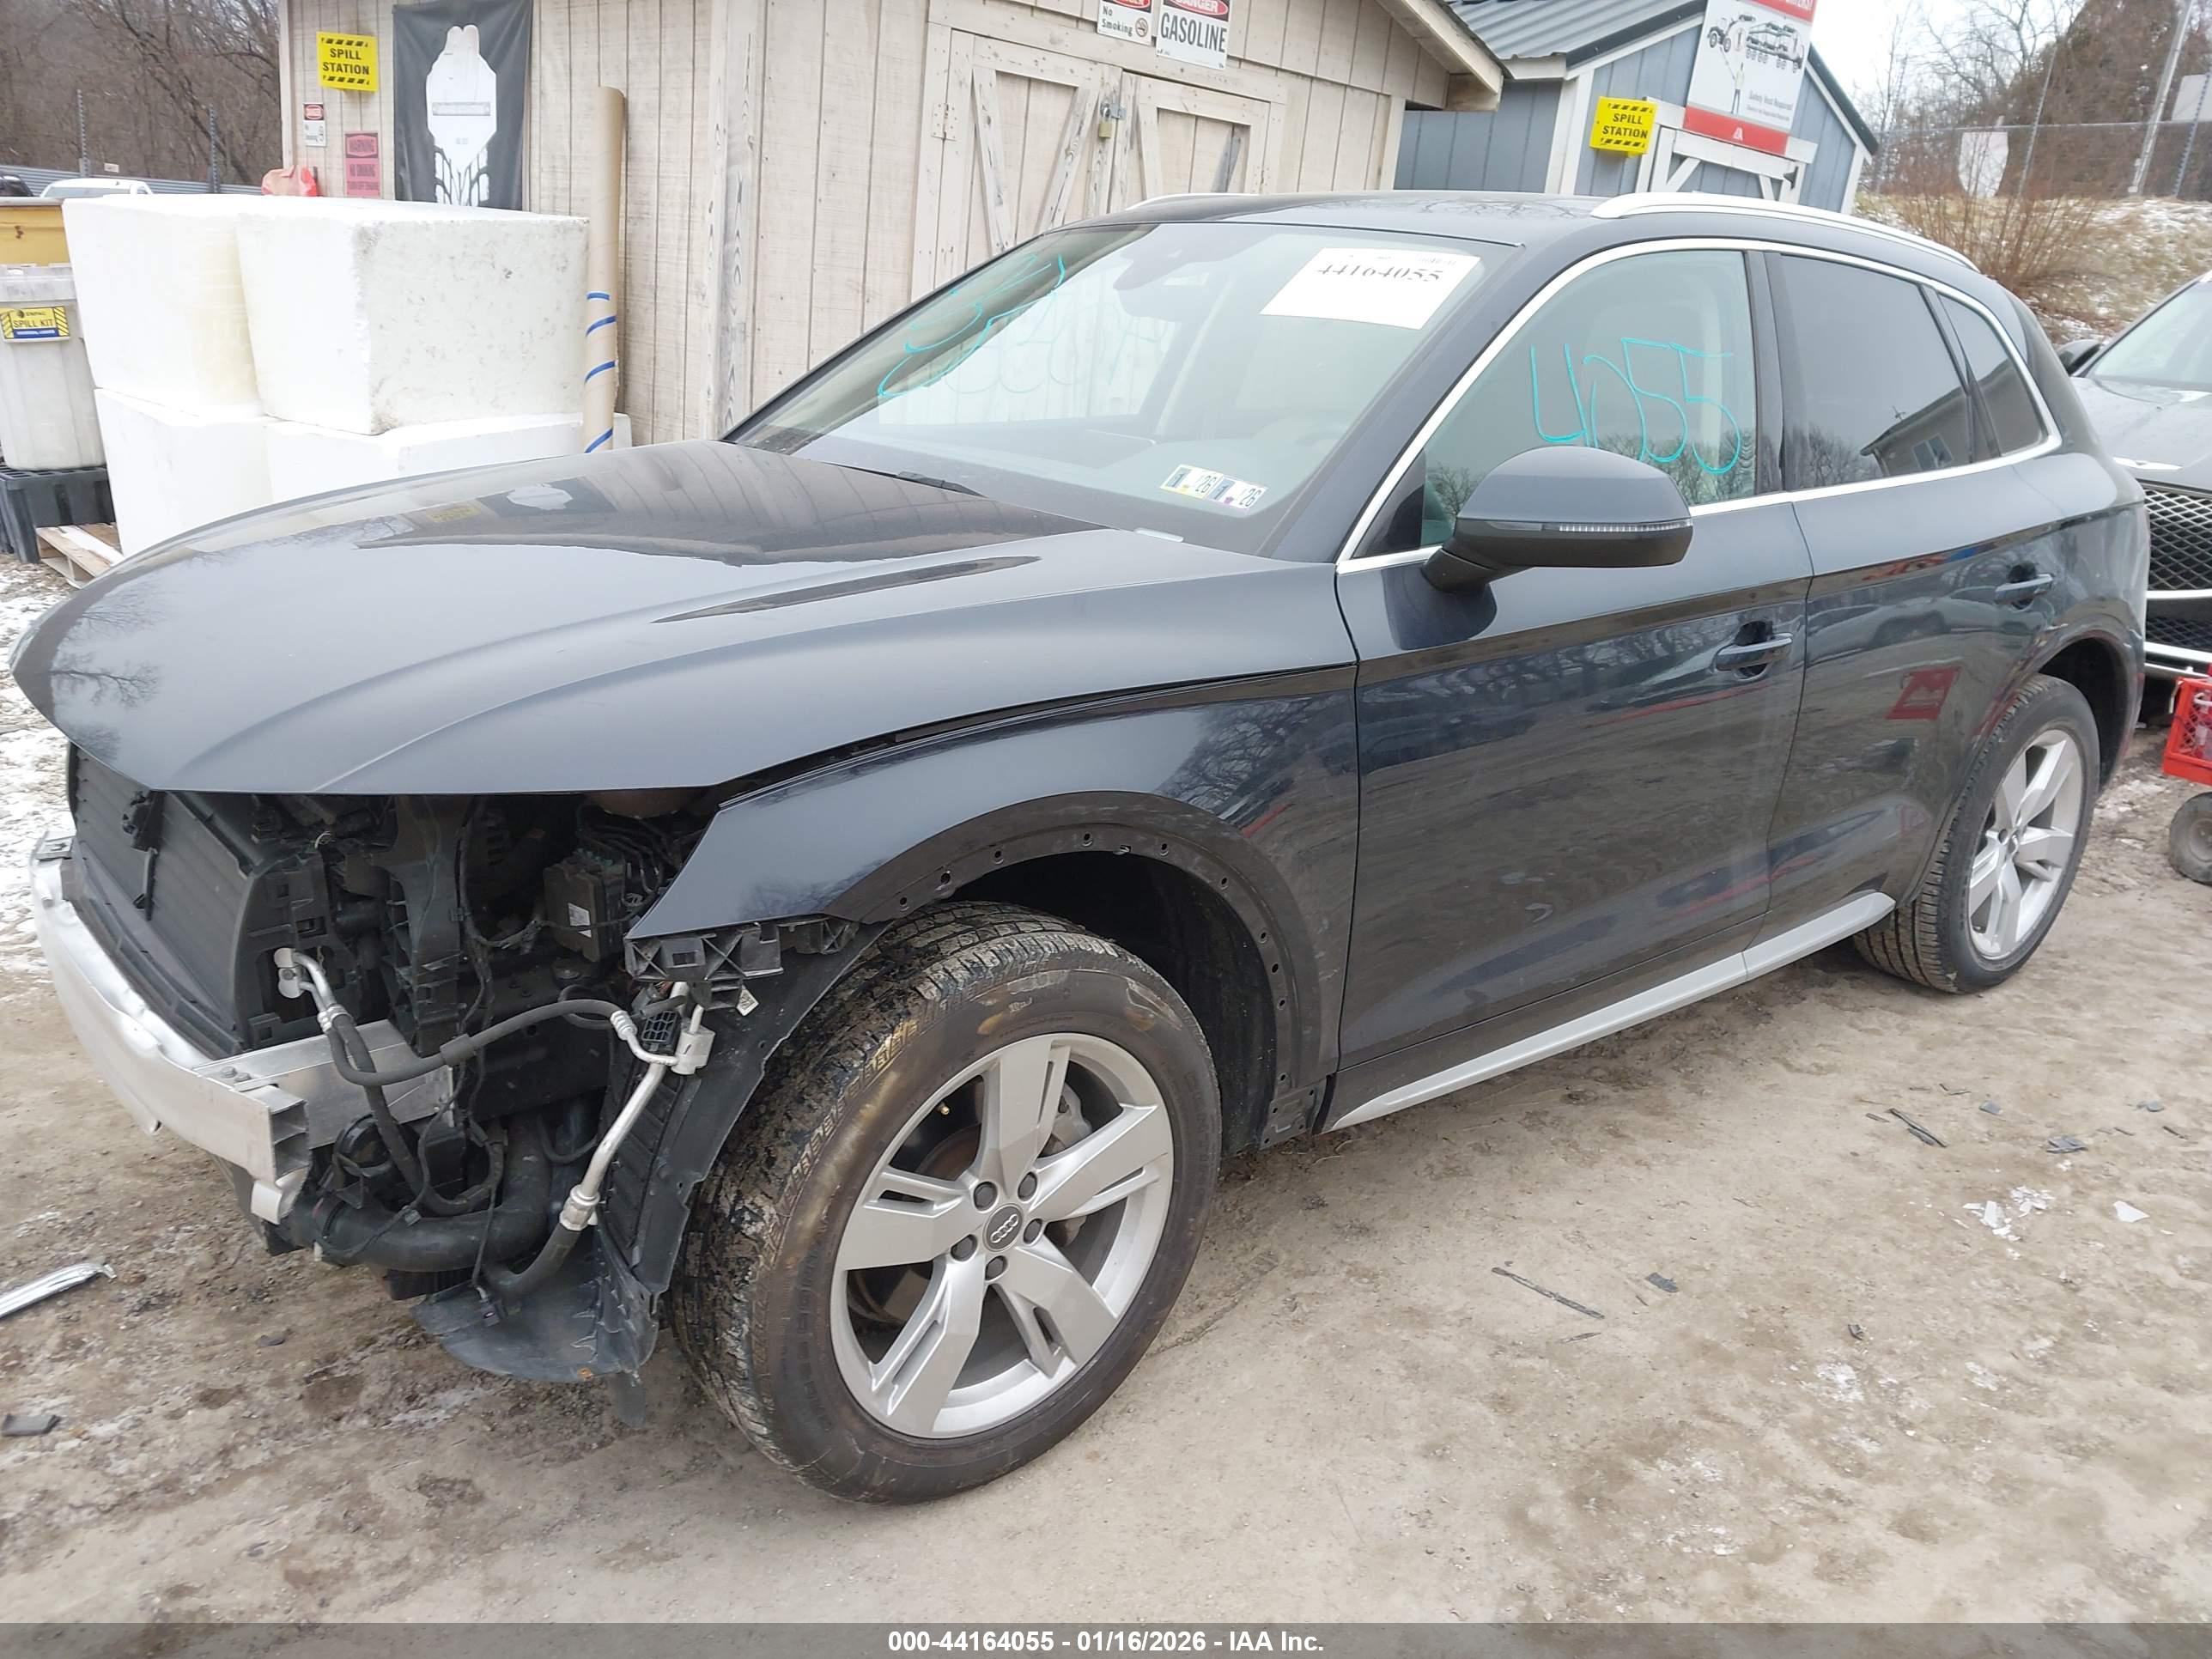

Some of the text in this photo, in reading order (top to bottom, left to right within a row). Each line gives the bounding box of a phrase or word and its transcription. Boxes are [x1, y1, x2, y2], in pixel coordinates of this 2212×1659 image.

[1103, 6, 1113, 16] No
[1102, 18, 1133, 37] Smoking
[1161, 12, 1227, 53] GASOLINE
[330, 48, 362, 60] SPILL
[322, 62, 370, 75] STATION
[1613, 113, 1643, 125] SPILL
[1602, 125, 1649, 139] STATION
